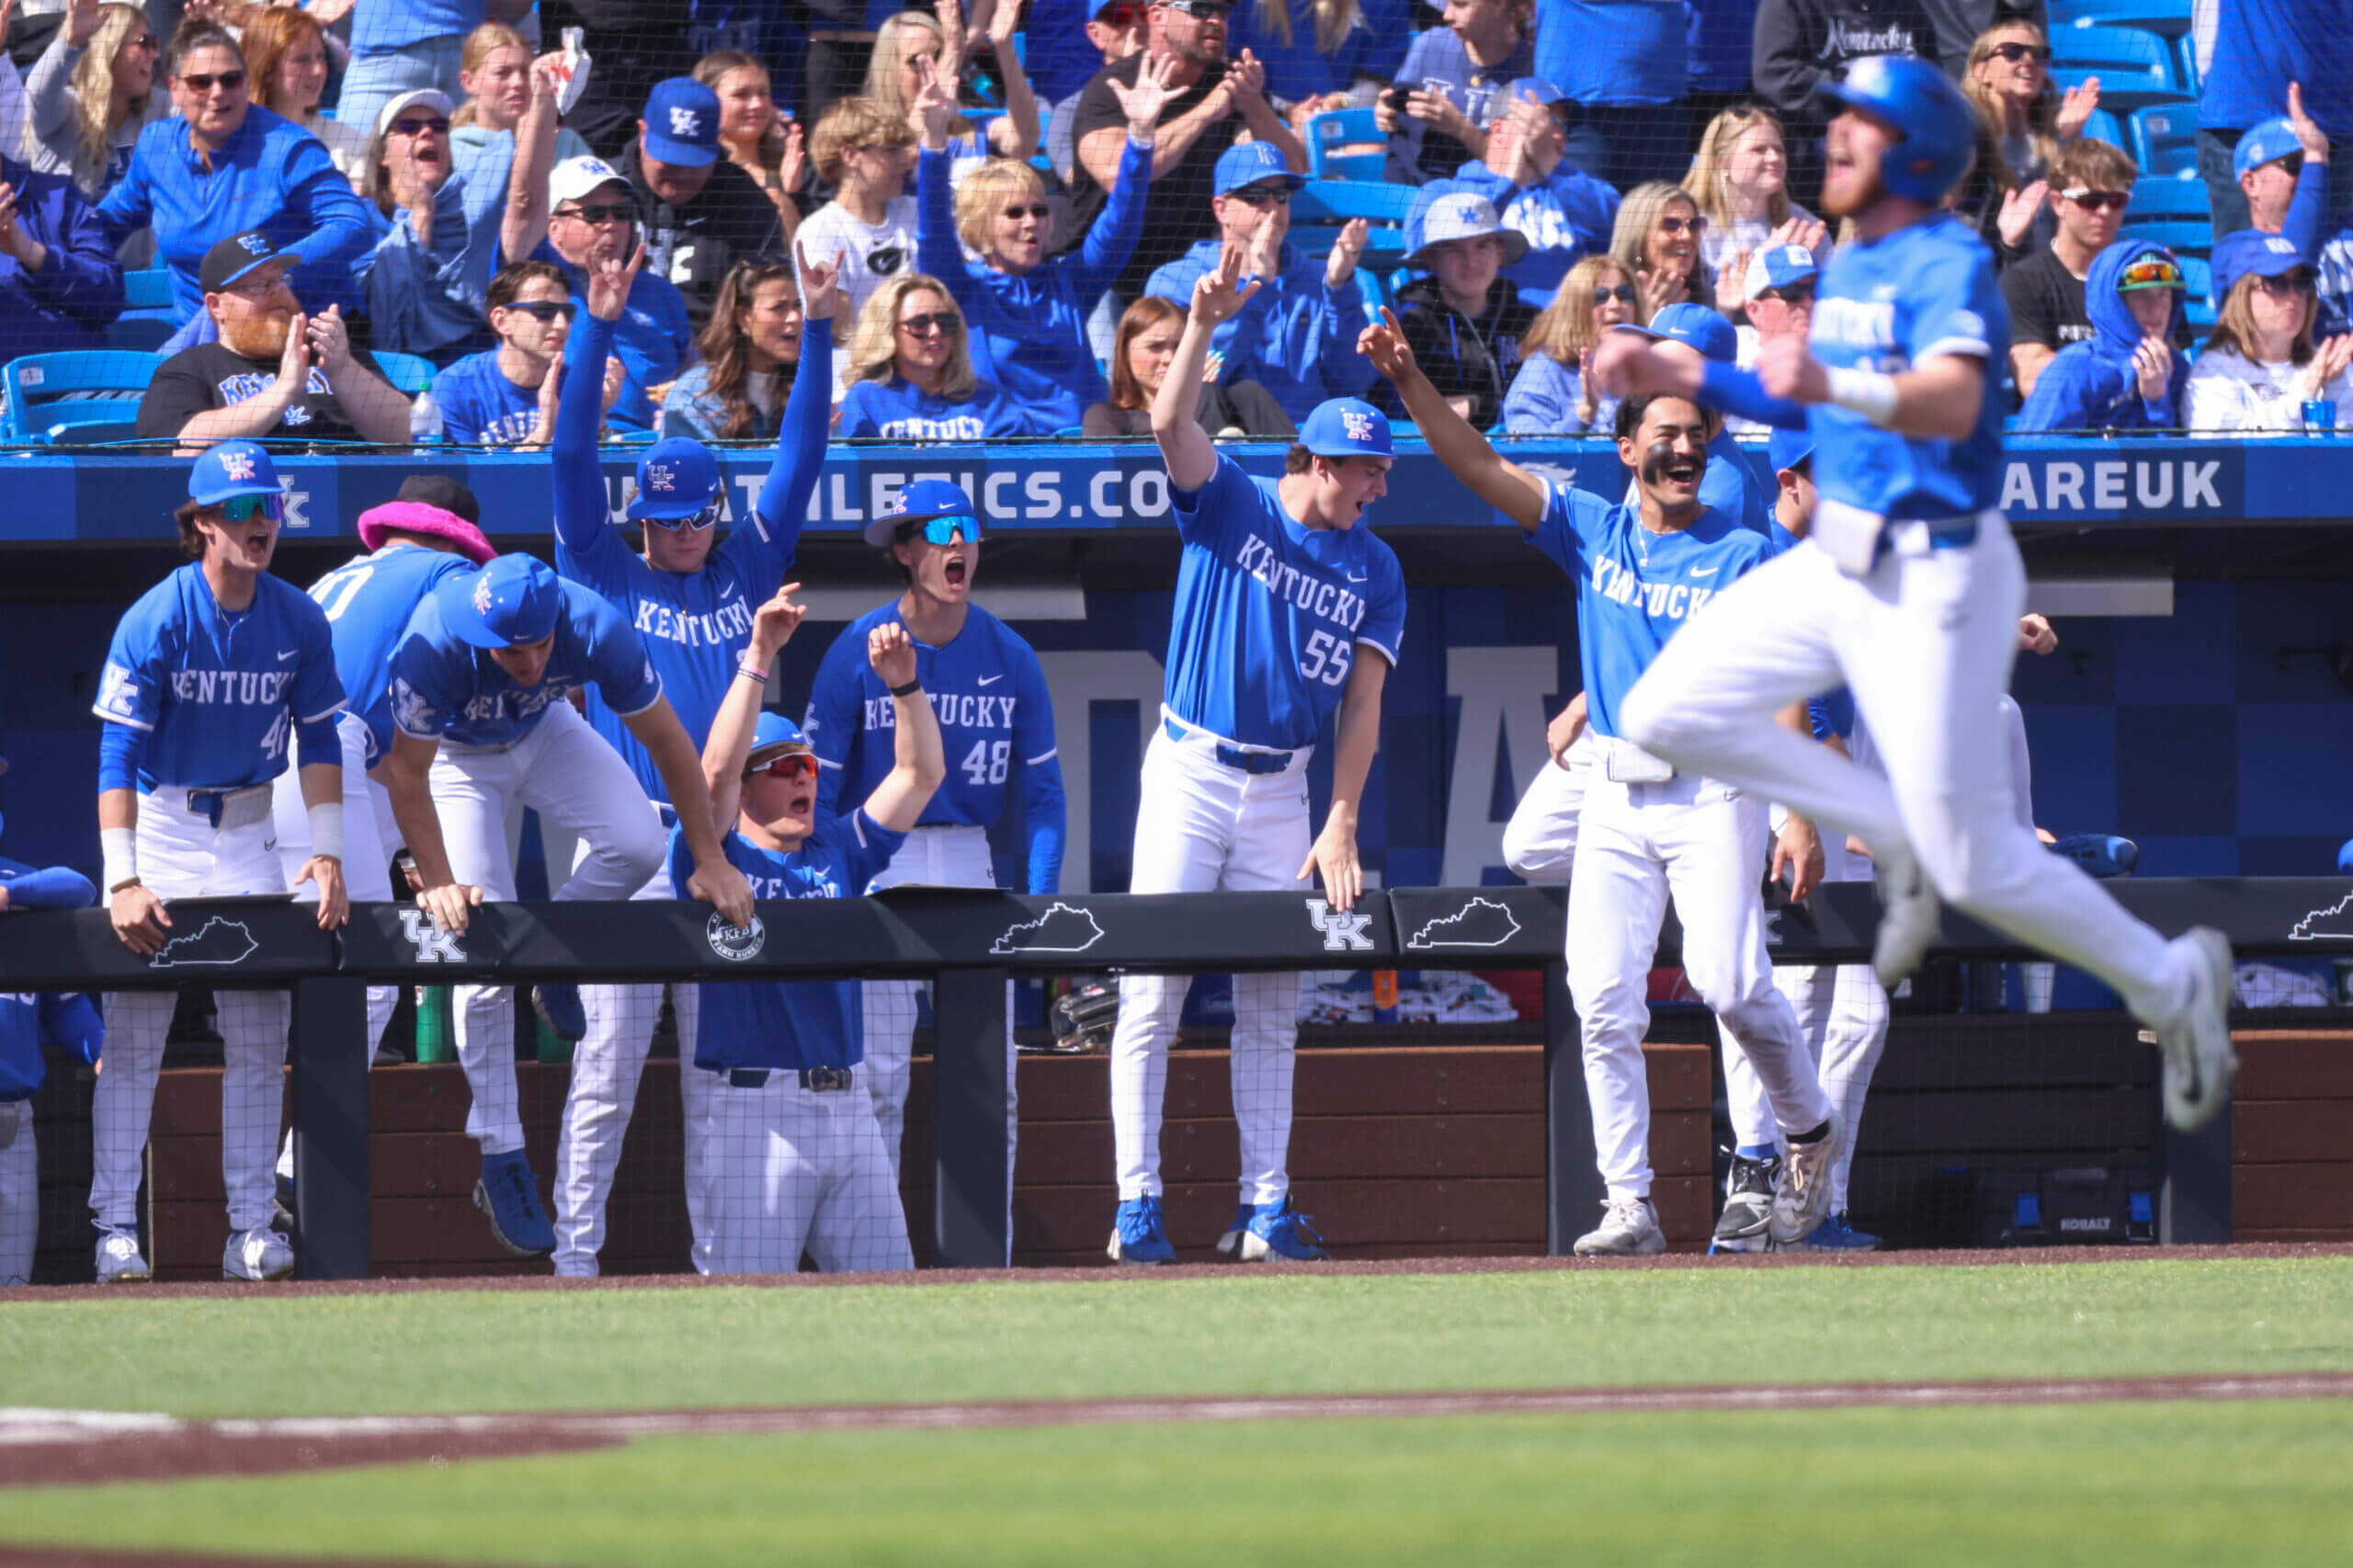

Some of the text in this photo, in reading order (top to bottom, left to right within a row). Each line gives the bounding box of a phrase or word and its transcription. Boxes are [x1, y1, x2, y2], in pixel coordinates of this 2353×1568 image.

[1343, 412, 1374, 441] UK
[218, 452, 256, 481] UK
[647, 465, 676, 491] UK
[604, 470, 1170, 524] UTLECS.CO
[1591, 554, 1722, 620] KENTUCK
[1300, 629, 1351, 687] 55
[171, 669, 297, 704] KENTUCK
[865, 694, 1017, 731] KEUCKY
[961, 740, 1012, 785] 48
